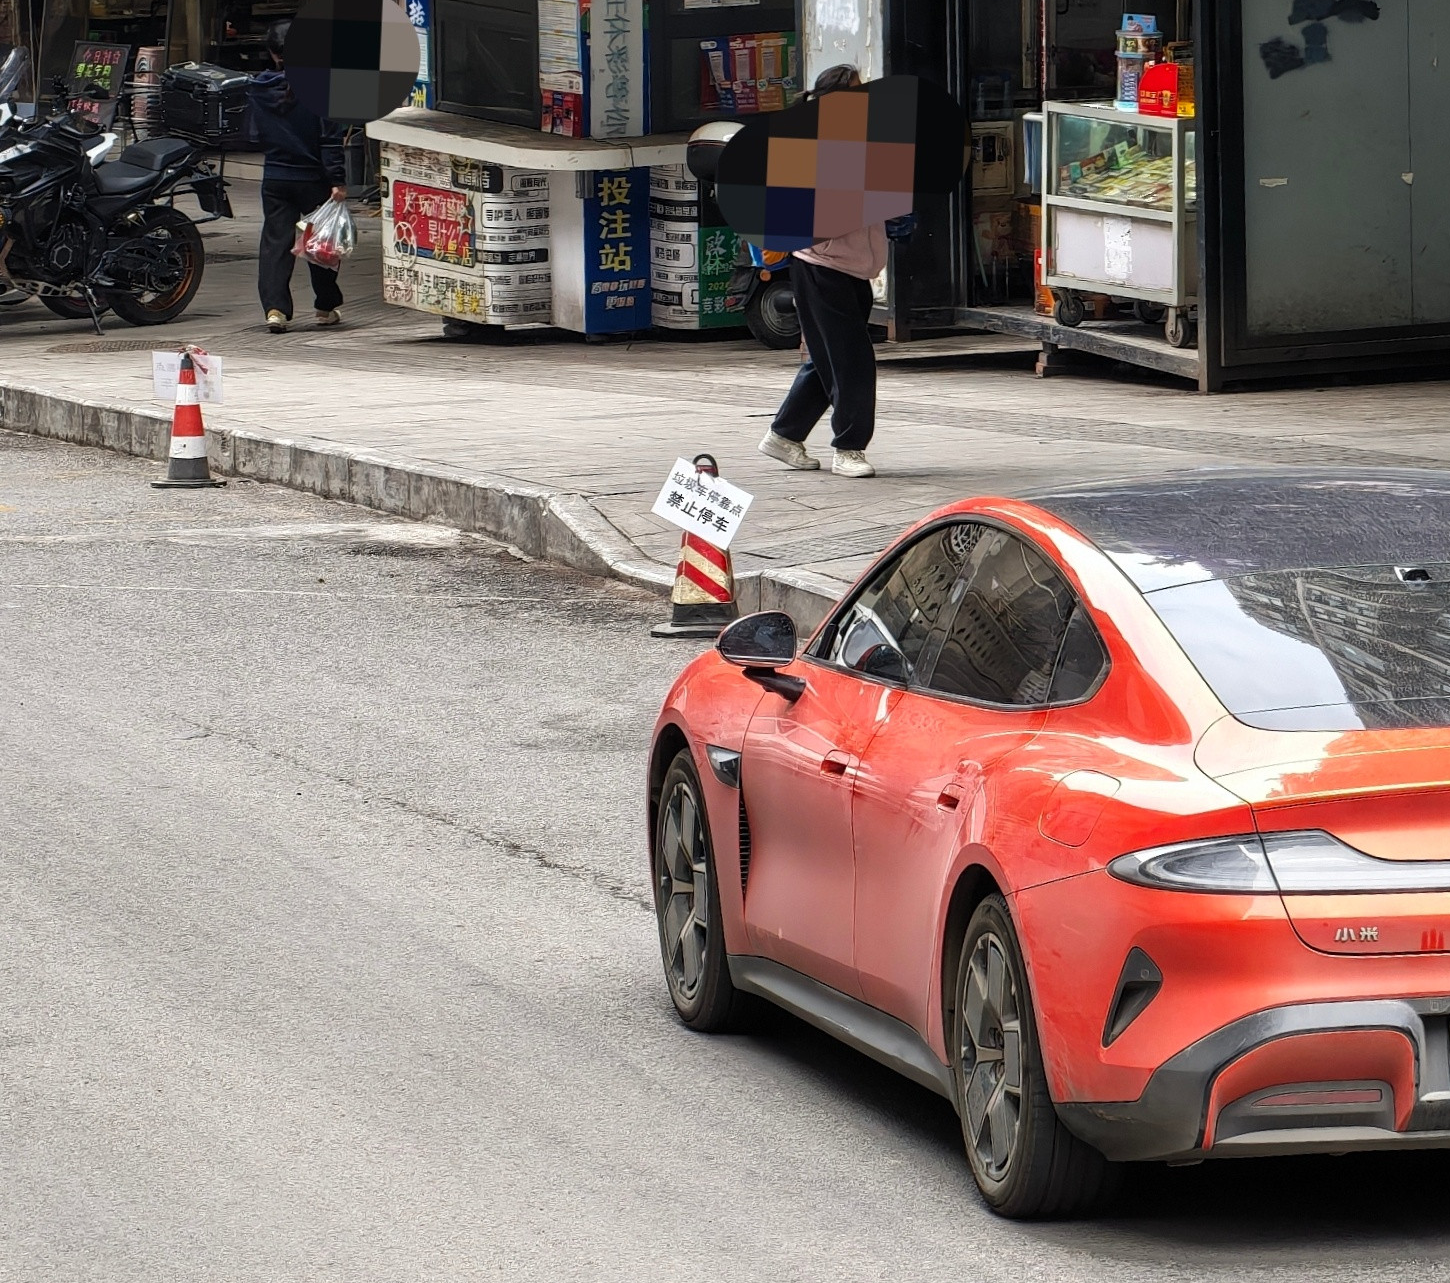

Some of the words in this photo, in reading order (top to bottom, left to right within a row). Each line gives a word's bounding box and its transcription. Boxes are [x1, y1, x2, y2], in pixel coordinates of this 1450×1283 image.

[598, 176, 633, 272] 投注站
[665, 490, 730, 534] 禁止停车
[671, 471, 745, 518] 垃圾车停靠点
[1334, 926, 1379, 942] 小米
